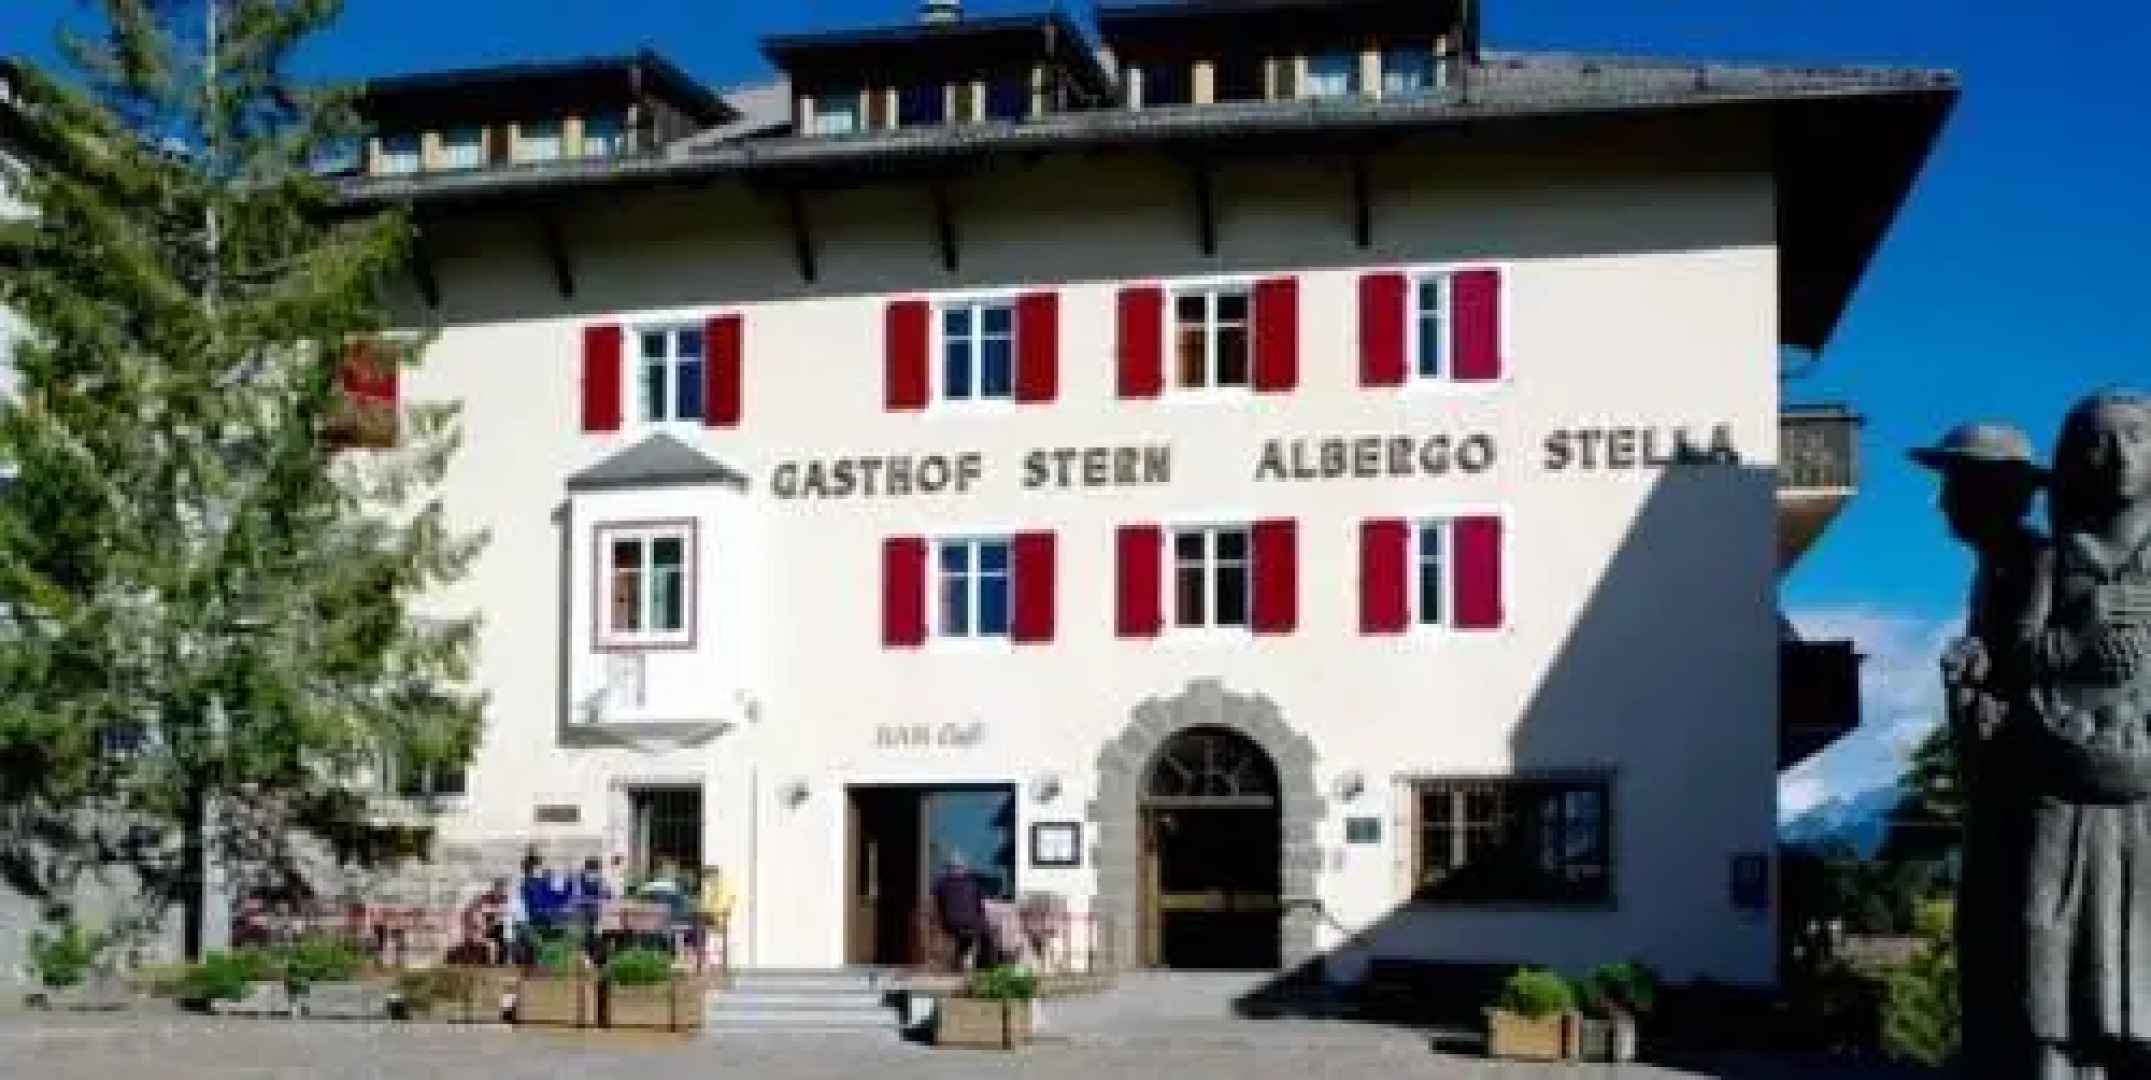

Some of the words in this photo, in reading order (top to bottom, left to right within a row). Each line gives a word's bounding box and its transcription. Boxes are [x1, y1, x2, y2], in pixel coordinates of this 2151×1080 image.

[771, 453, 982, 499] GASTHOF
[1021, 446, 1171, 490] STERN
[1255, 433, 1496, 481] ALBERGO
[1543, 423, 1740, 471] STELLA
